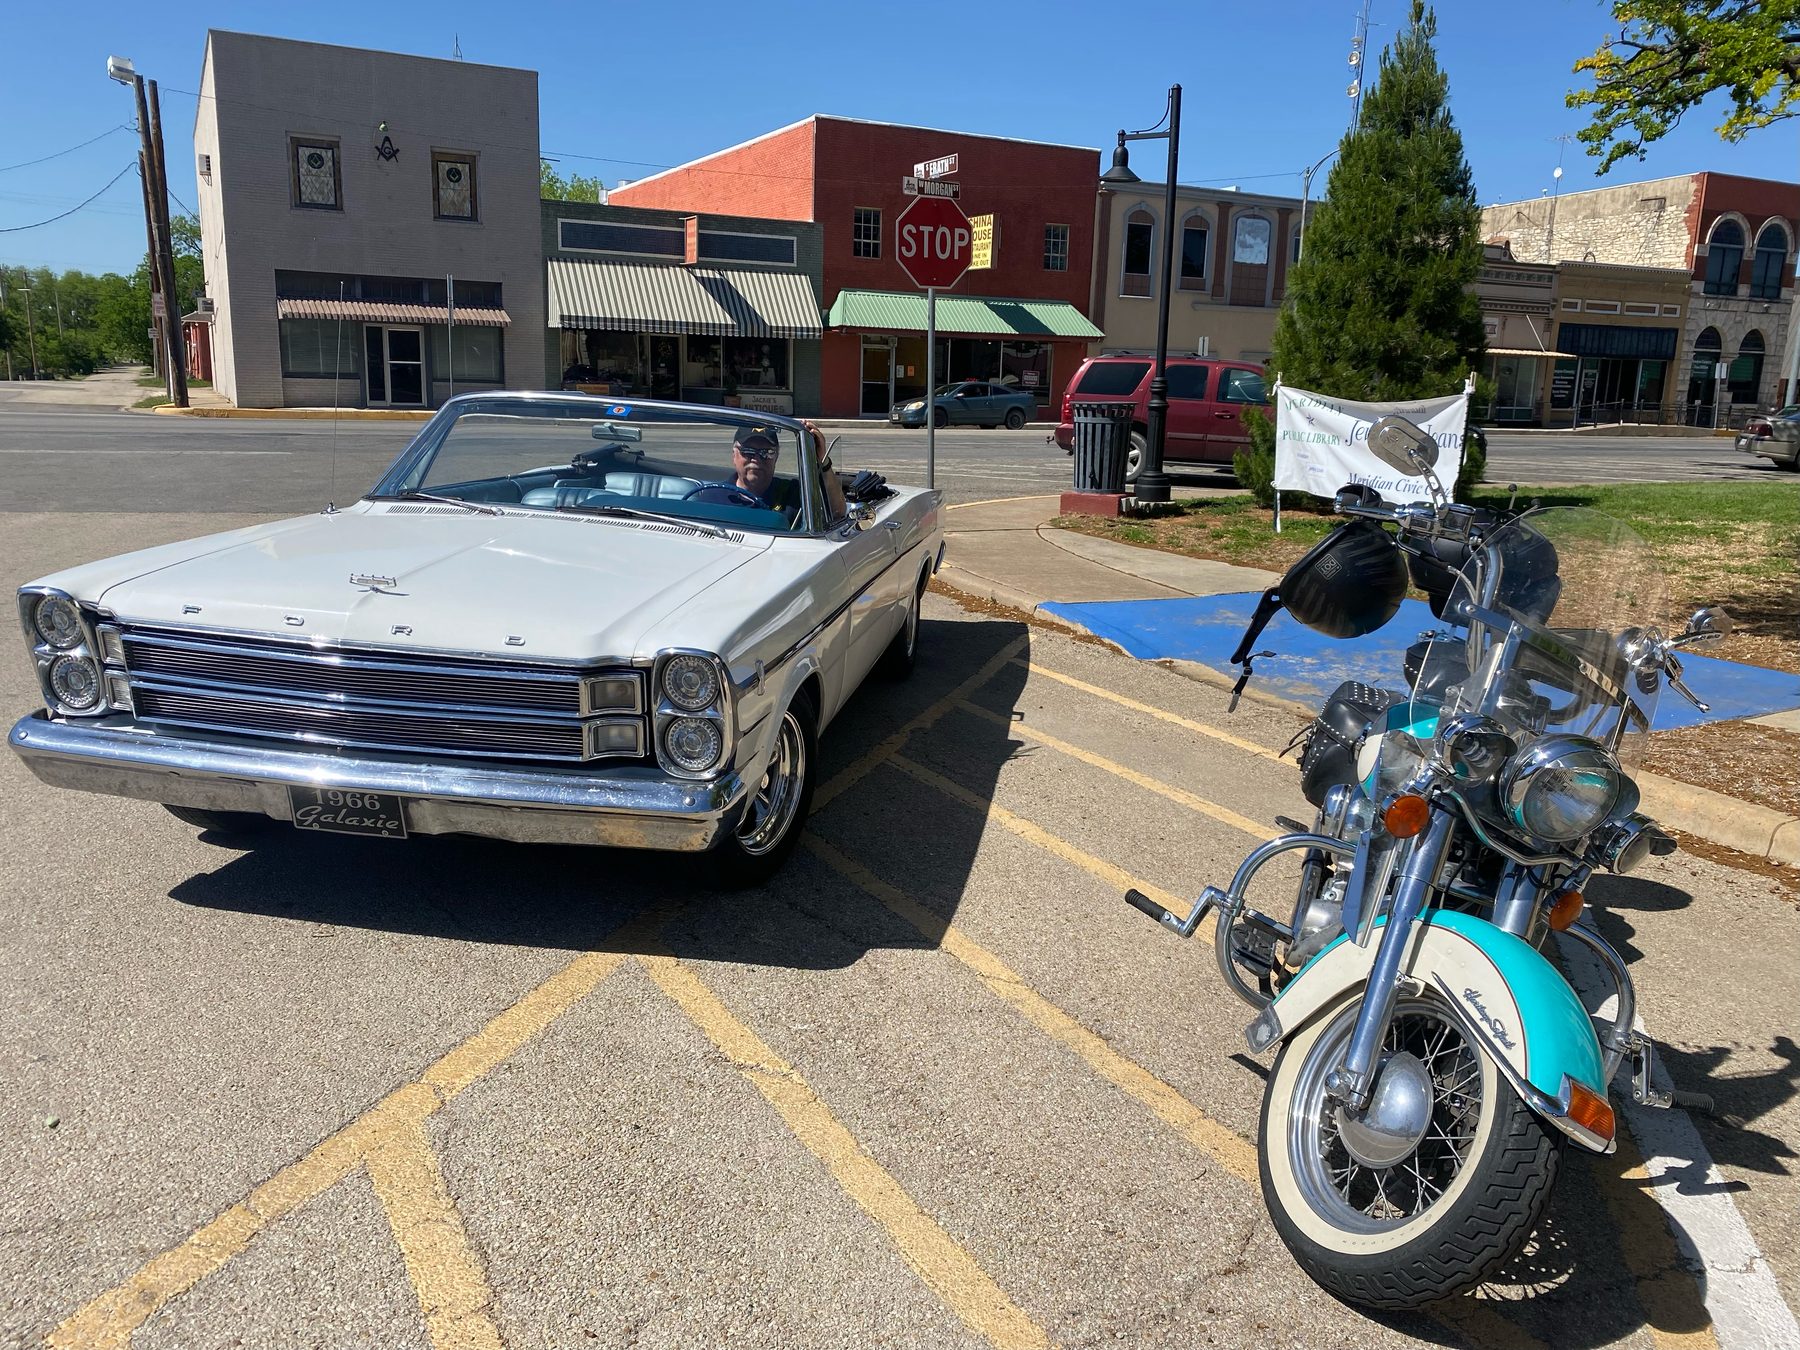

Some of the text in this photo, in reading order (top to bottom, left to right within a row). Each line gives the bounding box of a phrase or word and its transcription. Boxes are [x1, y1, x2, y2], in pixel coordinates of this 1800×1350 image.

[929, 158, 949, 175] ERATH
[949, 156, 956, 165] ST
[924, 180, 953, 197] MORGAN
[952, 184, 959, 192] ST
[901, 223, 969, 260] STOP
[972, 228, 992, 242] OUSE
[1306, 432, 1341, 446] LIBRARY
[1347, 472, 1394, 491] Meridian
[1395, 478, 1424, 496] Civic
[1321, 559, 1336, 574] DOT
[182, 603, 526, 647] FORD
[312, 788, 381, 811] 1966
[295, 805, 399, 830] Galaxie
